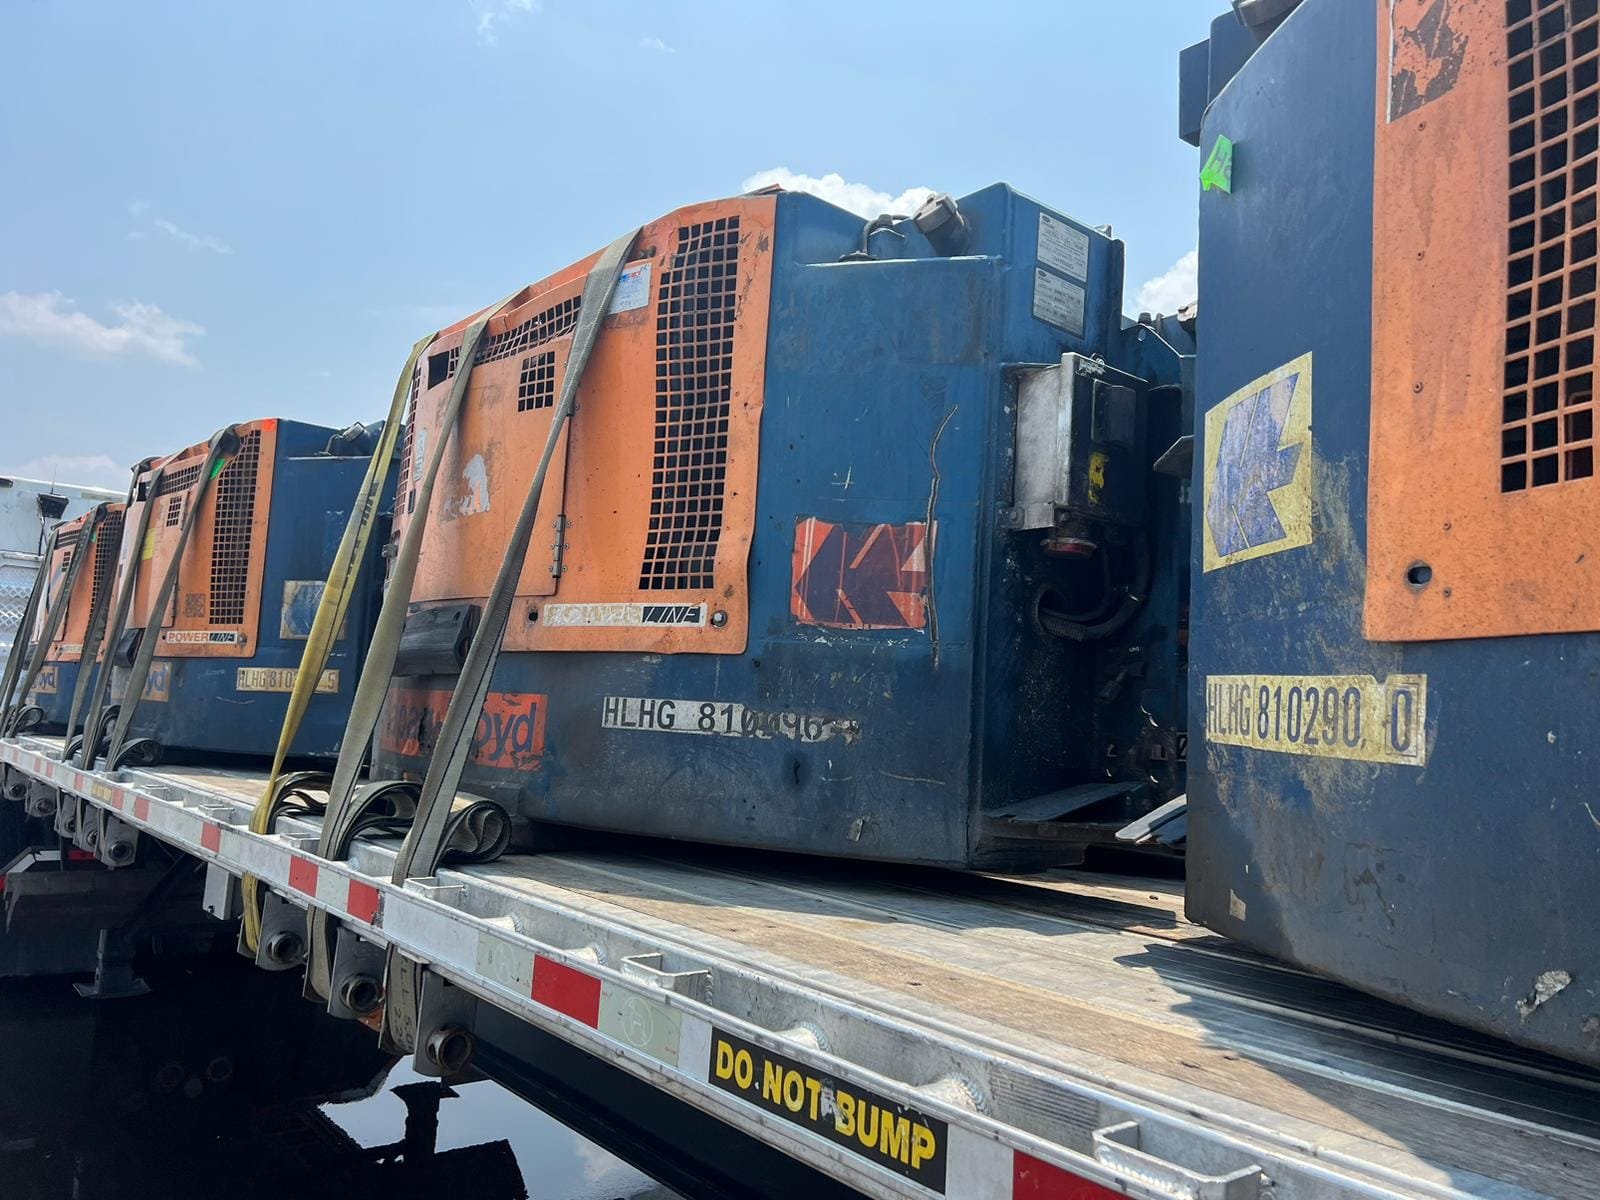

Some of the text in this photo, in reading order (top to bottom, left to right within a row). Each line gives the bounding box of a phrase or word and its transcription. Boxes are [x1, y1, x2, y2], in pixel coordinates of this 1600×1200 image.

[168, 632, 209, 642] POWER
[603, 698, 676, 730] HLHG
[1391, 688, 1413, 751] 0
[716, 1039, 936, 1169] DO NOT BUMP
